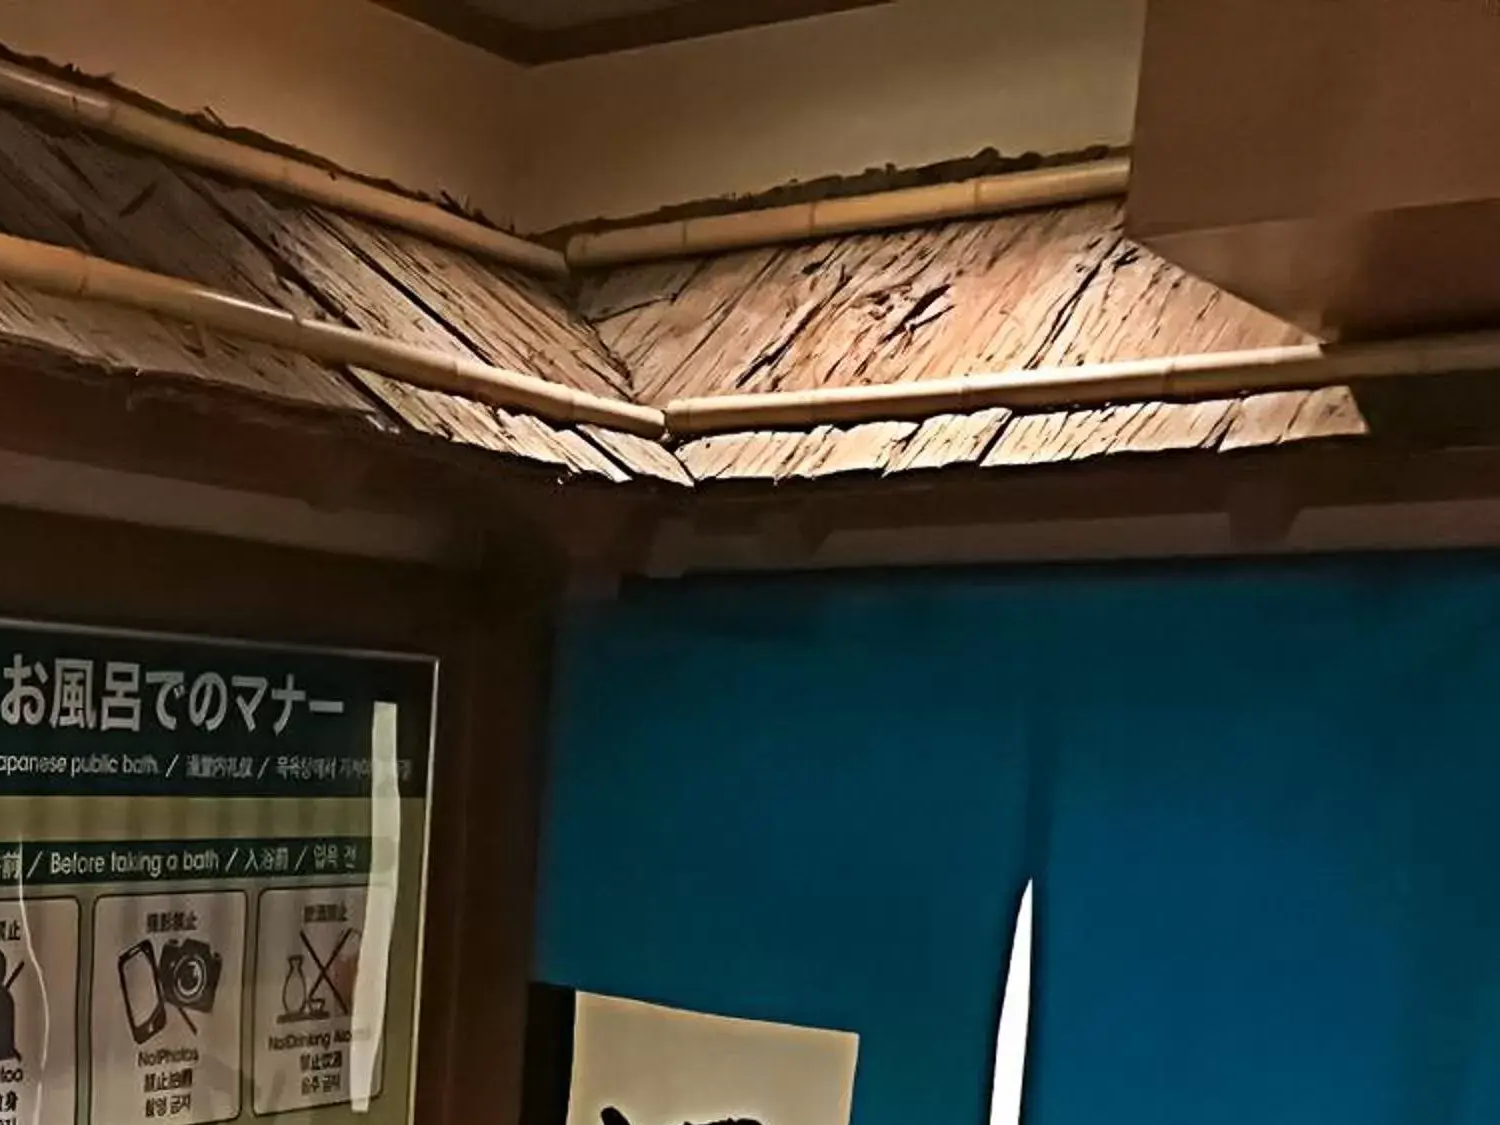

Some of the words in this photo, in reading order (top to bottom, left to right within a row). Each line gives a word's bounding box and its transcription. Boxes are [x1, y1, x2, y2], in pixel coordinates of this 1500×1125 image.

[0, 653, 344, 736] お風呂でのマナー
[71, 753, 119, 778] public
[122, 754, 159, 774] bath
[51, 852, 105, 874] Before
[110, 850, 161, 878] taking
[166, 857, 178, 870] a
[183, 850, 219, 872] bath
